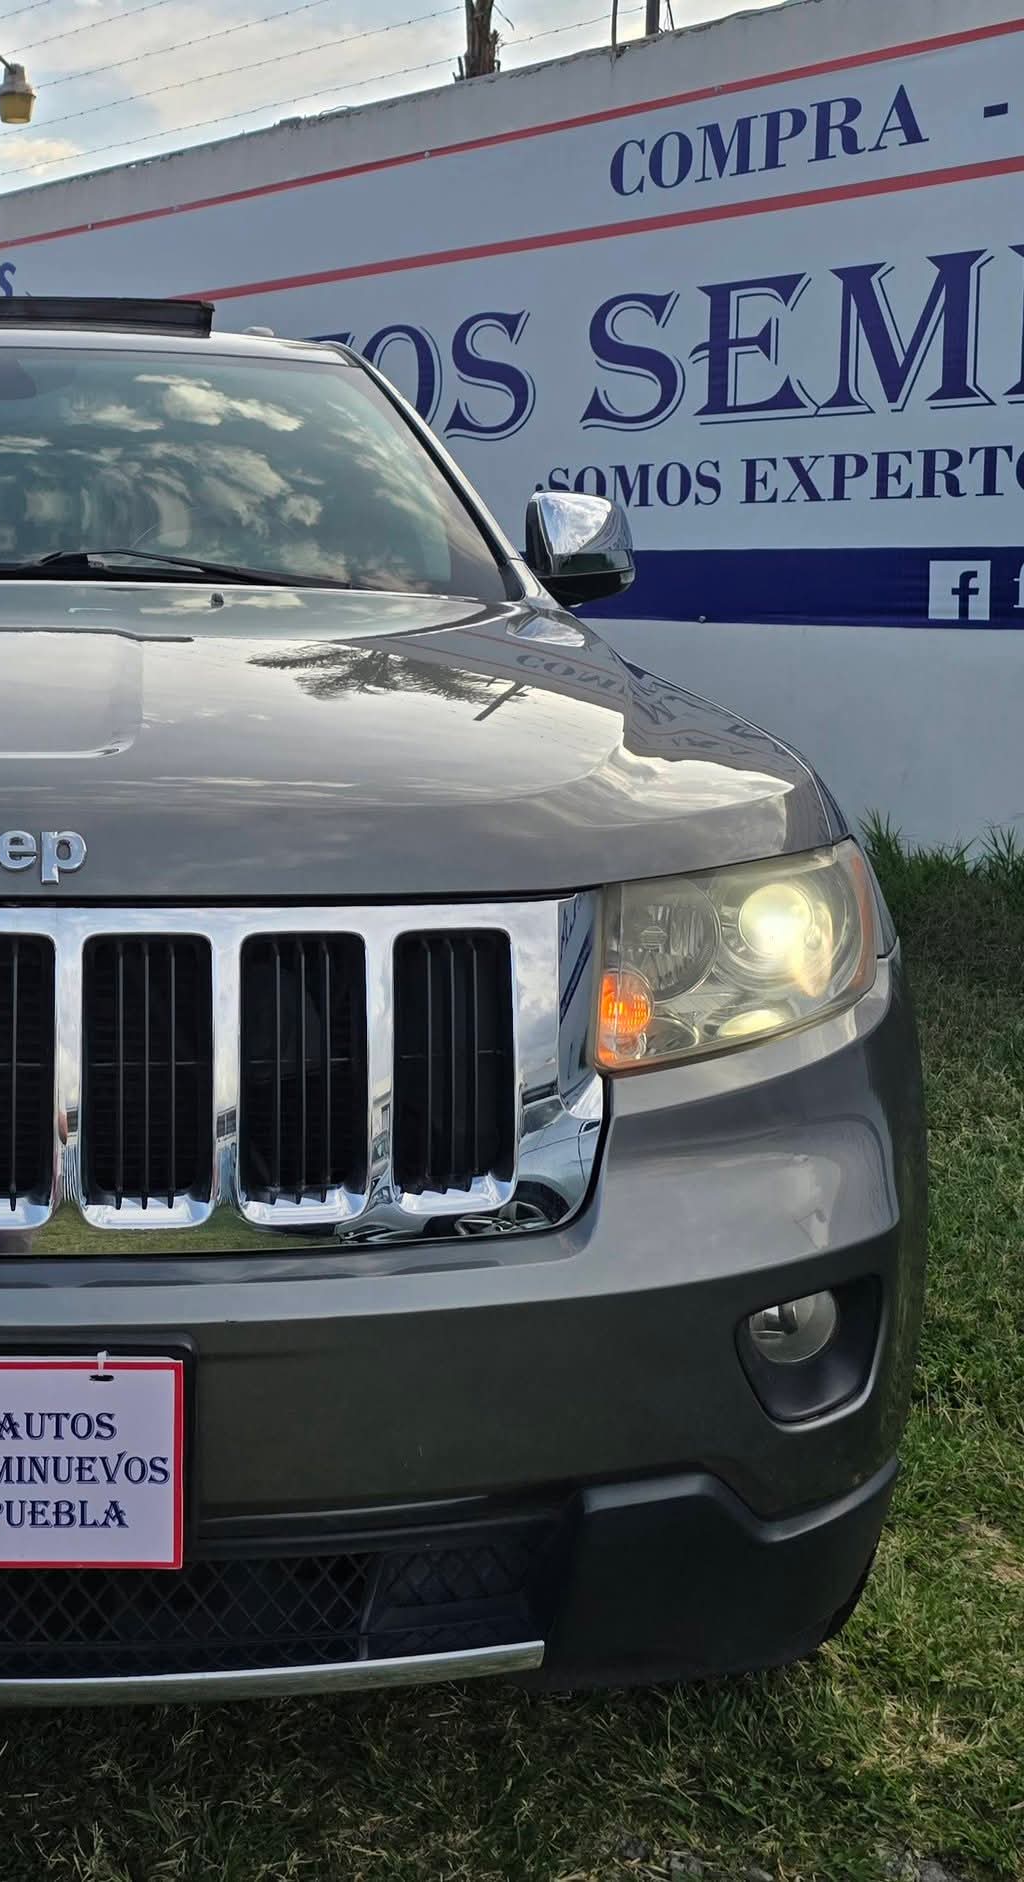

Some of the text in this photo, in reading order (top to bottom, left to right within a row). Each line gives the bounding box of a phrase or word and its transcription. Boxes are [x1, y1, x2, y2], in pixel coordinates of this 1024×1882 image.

[610, 84, 929, 197] COMPRA
[302, 310, 536, 441] OS
[739, 445, 1024, 504] EXPERT
